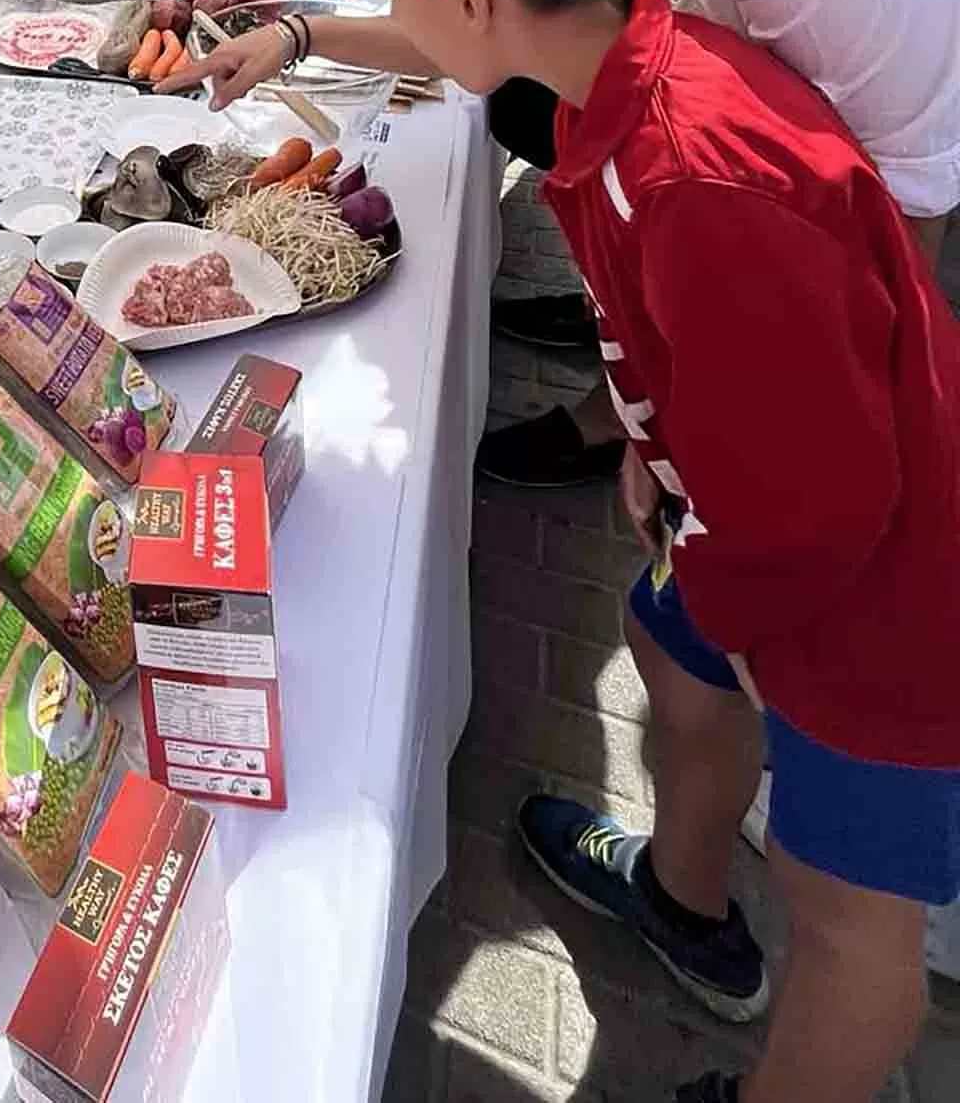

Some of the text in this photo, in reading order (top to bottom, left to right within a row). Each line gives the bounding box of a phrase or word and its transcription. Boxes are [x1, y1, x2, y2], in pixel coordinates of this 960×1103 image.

[213, 496, 236, 569] ΚΑΦΕΣ
[72, 868, 104, 928] HEALTHY
[88, 889, 106, 919] WAY
[102, 925, 153, 1027] ΣΚΕΤΟΣ
[143, 849, 183, 927] ΚΑΦΕΣ
